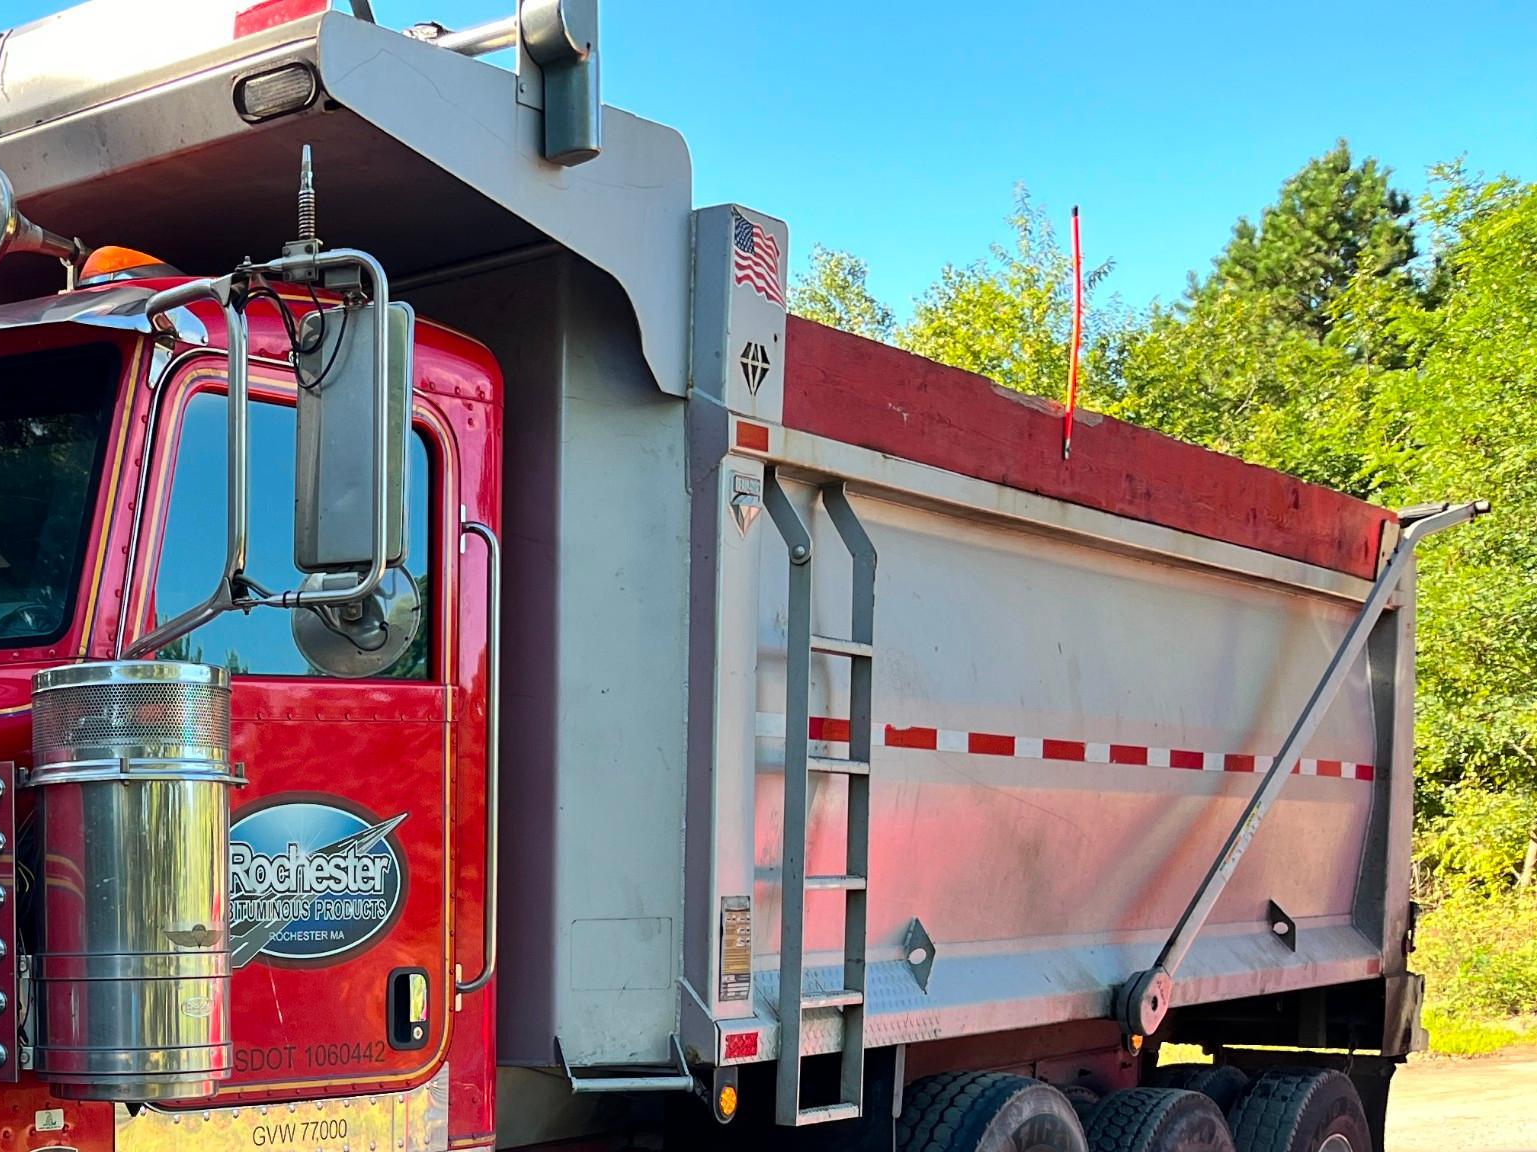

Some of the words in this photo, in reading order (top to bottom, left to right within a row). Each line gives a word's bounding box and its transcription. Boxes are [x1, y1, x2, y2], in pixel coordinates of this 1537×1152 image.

[230, 841, 392, 895] Rochester
[314, 898, 387, 920] PRODUCTS
[269, 930, 328, 942] ROCHESTER
[330, 930, 345, 941] MA
[234, 1045, 297, 1073] SDOT
[304, 1040, 385, 1069] 1060442
[252, 1123, 296, 1147] GVW
[300, 1118, 348, 1143] 77,000
